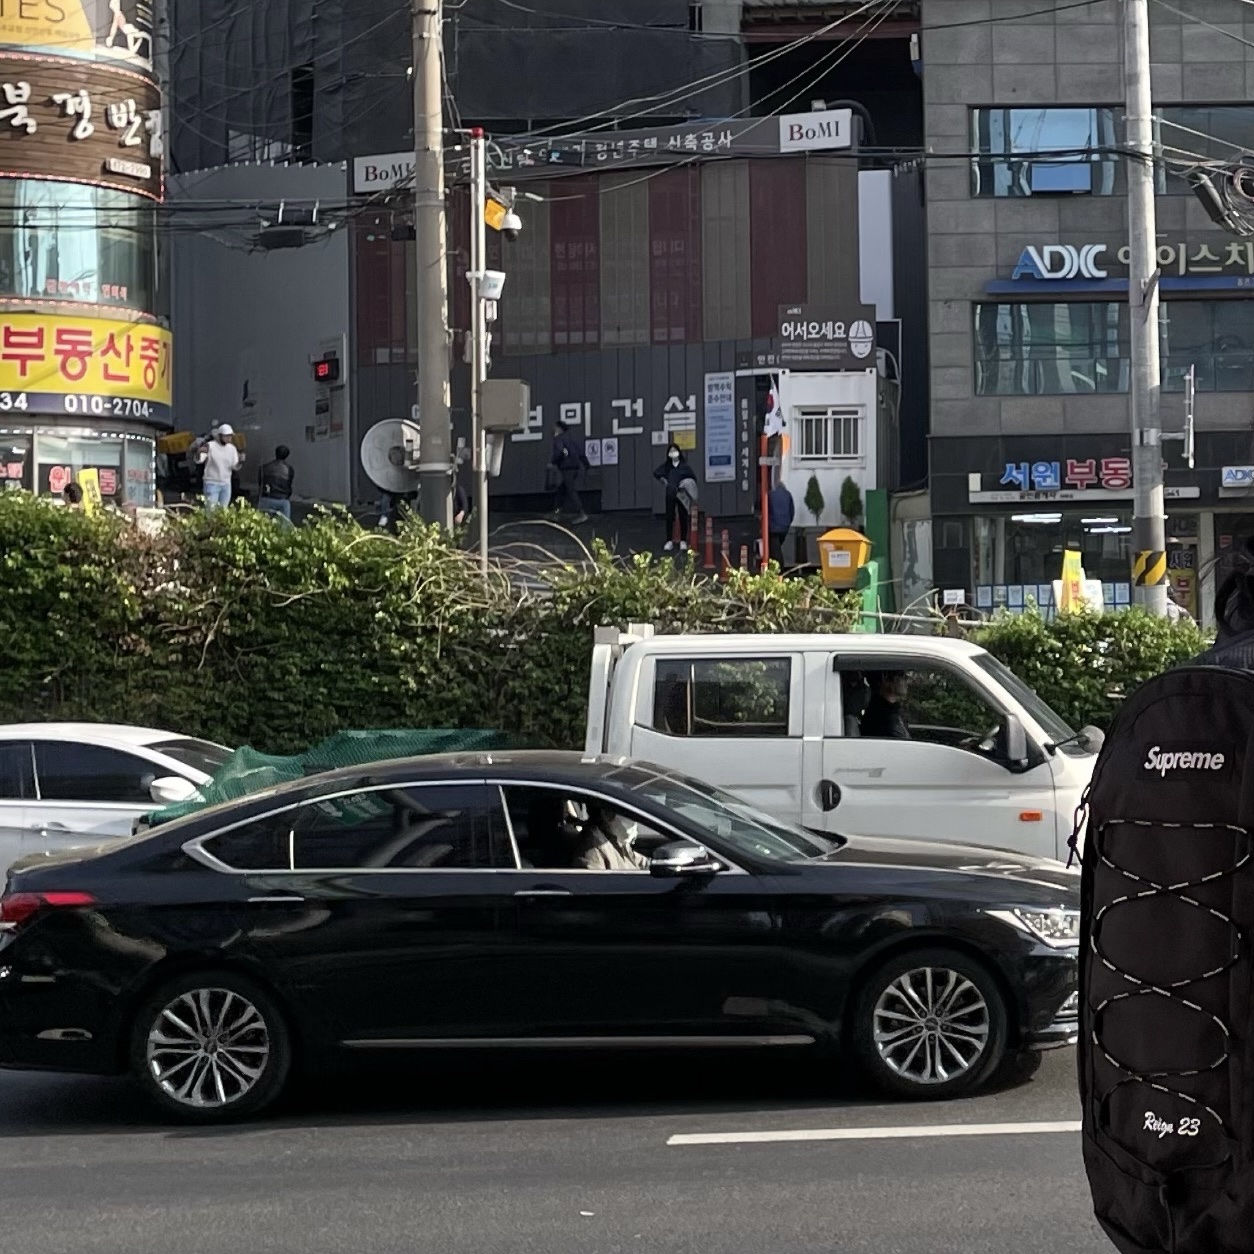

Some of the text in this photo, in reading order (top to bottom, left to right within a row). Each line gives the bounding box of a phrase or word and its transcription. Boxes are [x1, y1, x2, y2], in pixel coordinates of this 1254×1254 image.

[788, 120, 841, 141] BoMI
[781, 321, 847, 341] 어서오세요
[1000, 457, 1168, 492] 서원부동
[1144, 745, 1225, 778] Supreme
[1177, 1117, 1201, 1136] 23
